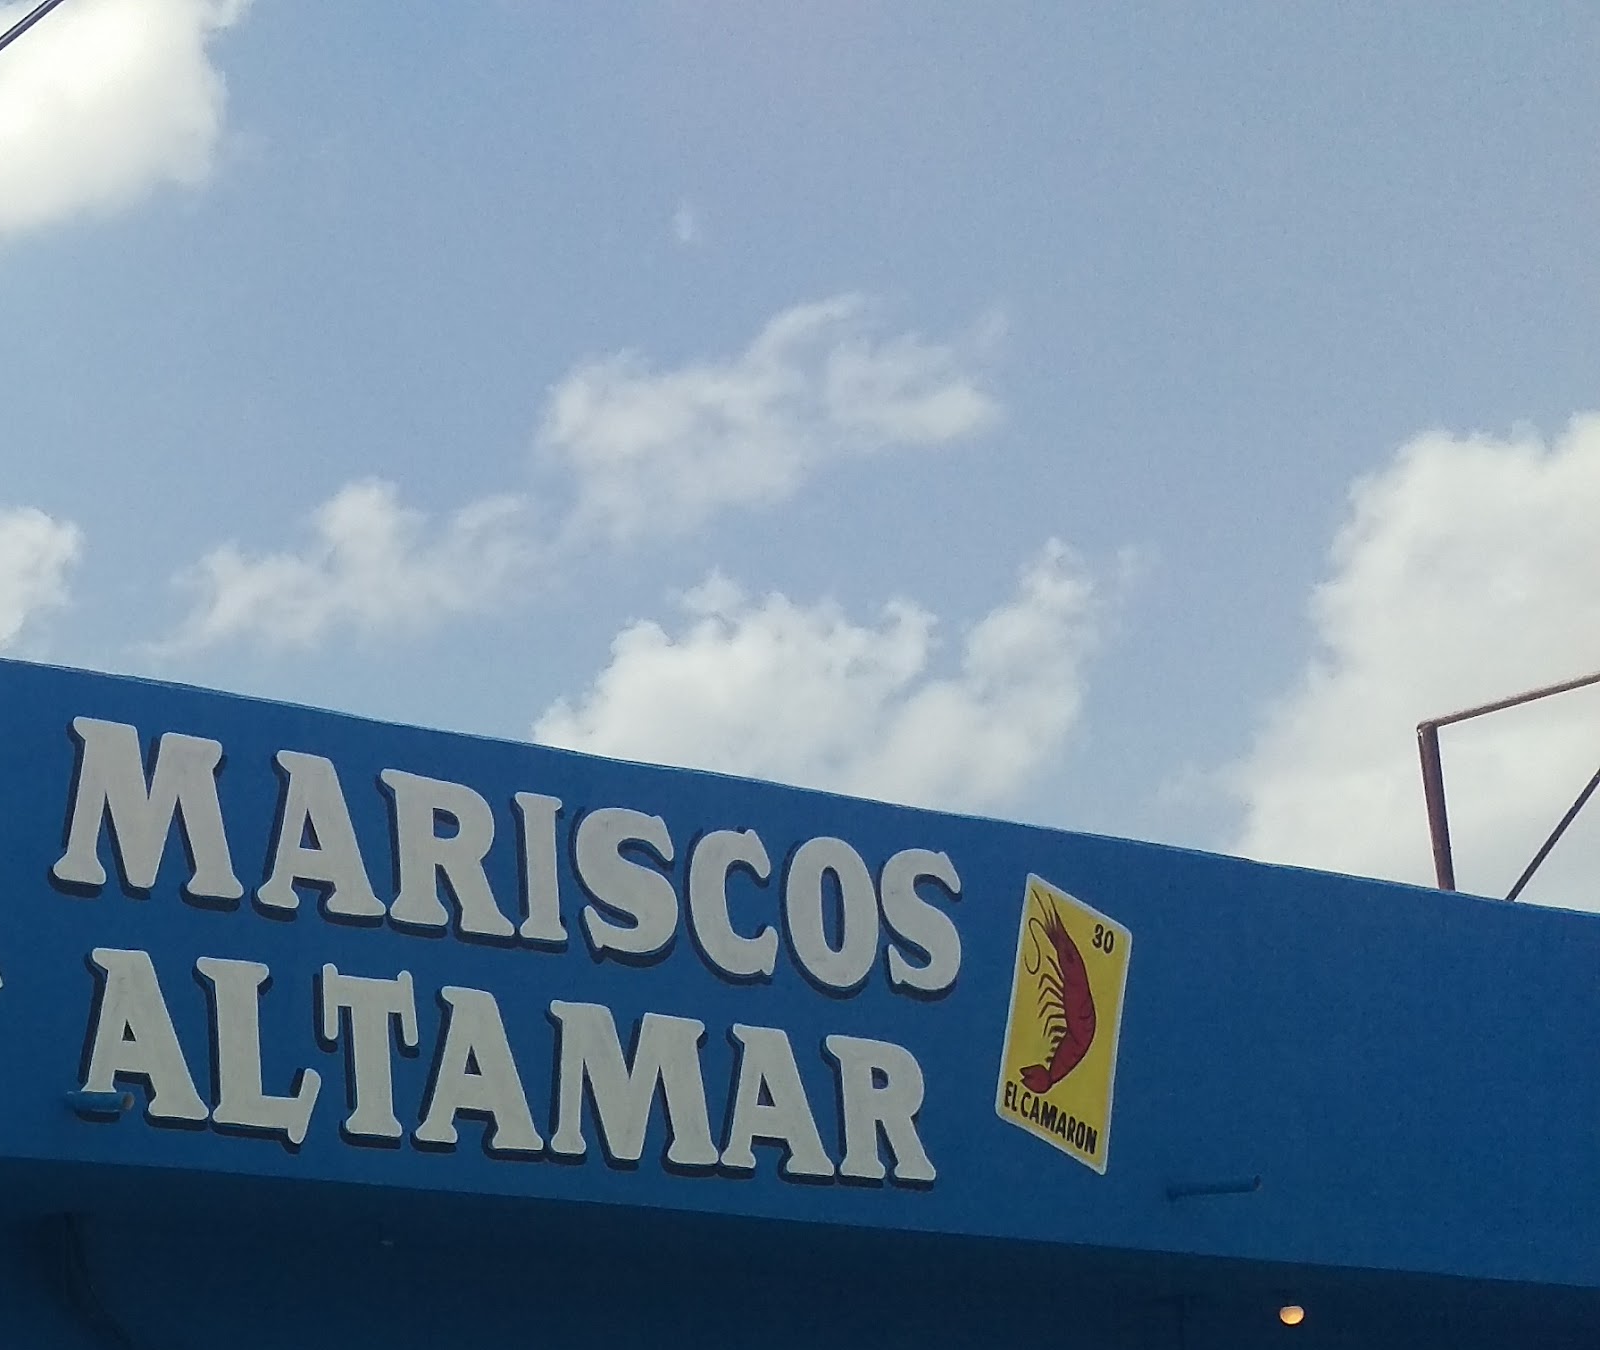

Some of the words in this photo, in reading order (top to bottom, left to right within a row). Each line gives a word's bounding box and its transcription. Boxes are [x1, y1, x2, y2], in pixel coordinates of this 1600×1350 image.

[50, 716, 964, 1001] MARISCOS
[1091, 923, 1115, 954] 30
[77, 945, 939, 1187] ALTAMAR
[1003, 1081, 1020, 1113] EL
[1019, 1087, 1098, 1155] CAMARON
